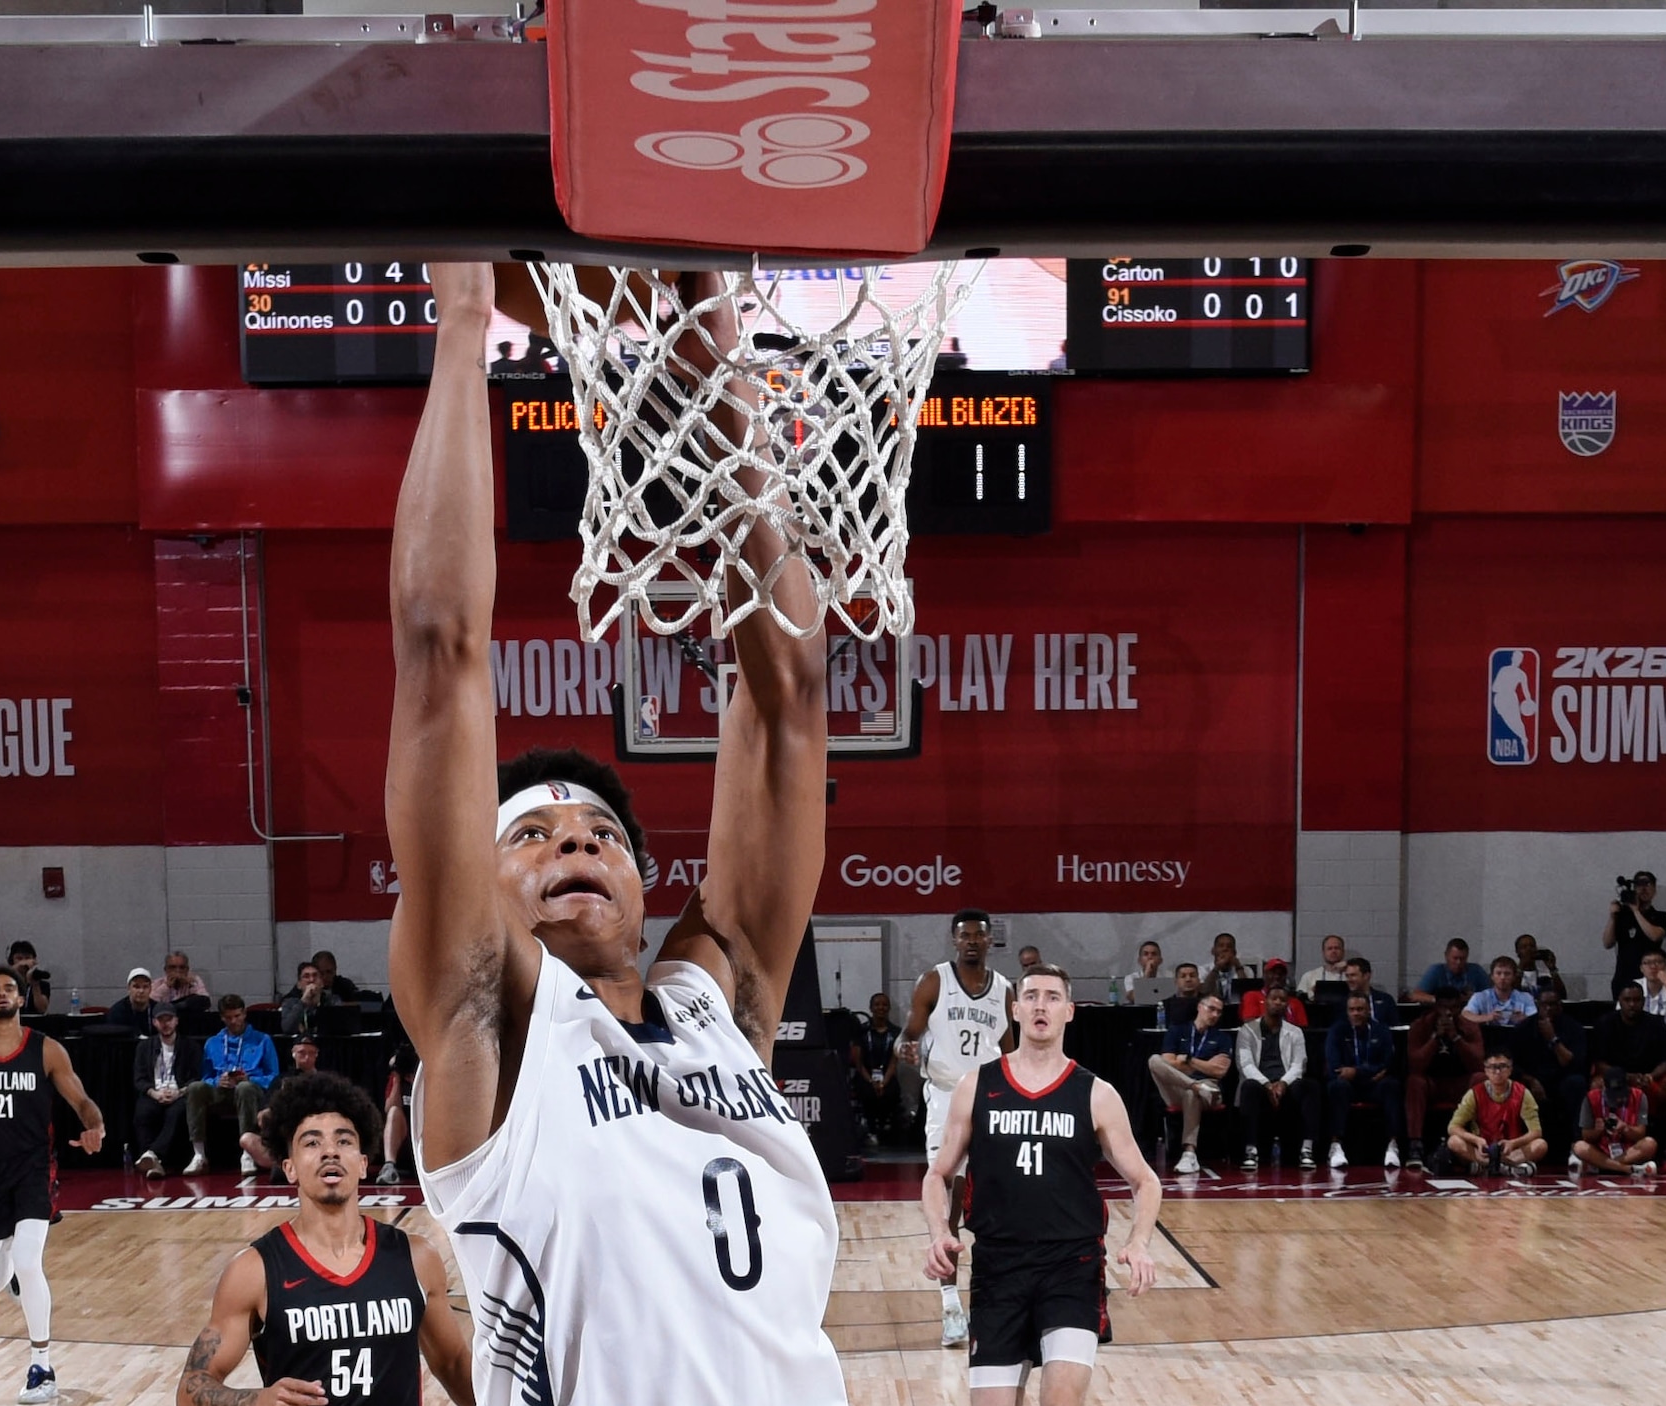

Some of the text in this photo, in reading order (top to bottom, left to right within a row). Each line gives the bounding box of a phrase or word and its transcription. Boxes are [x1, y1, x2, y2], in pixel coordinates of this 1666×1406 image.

[244, 271, 291, 288] Missi
[385, 262, 403, 283] 4
[1102, 264, 1164, 281] Carton
[248, 294, 272, 312] 30
[1102, 293, 1298, 323] Cissoko 0 0 1
[1108, 288, 1130, 305] 91
[244, 312, 333, 330] Quinones
[346, 299, 364, 324] 0
[388, 300, 406, 325] 0
[487, 372, 547, 380] AKTRONICS
[1561, 417, 1614, 430] KINGS
[910, 633, 1013, 712] PLAY
[1034, 633, 1138, 711] HERE
[1494, 739, 1520, 758] NBA
[841, 853, 962, 895] Google
[1056, 854, 1191, 888] Hennessy
[947, 1006, 966, 1022] NEW
[775, 1022, 807, 1041] 26
[959, 1029, 981, 1057] 21
[577, 1055, 661, 1127] NEW
[988, 1110, 1075, 1138] PORTLAND
[1016, 1141, 1043, 1176] 41
[90, 1195, 408, 1210] SUMMR
[702, 1156, 763, 1292] 0
[284, 1298, 414, 1344] PORTLAND
[330, 1347, 374, 1397] 54
